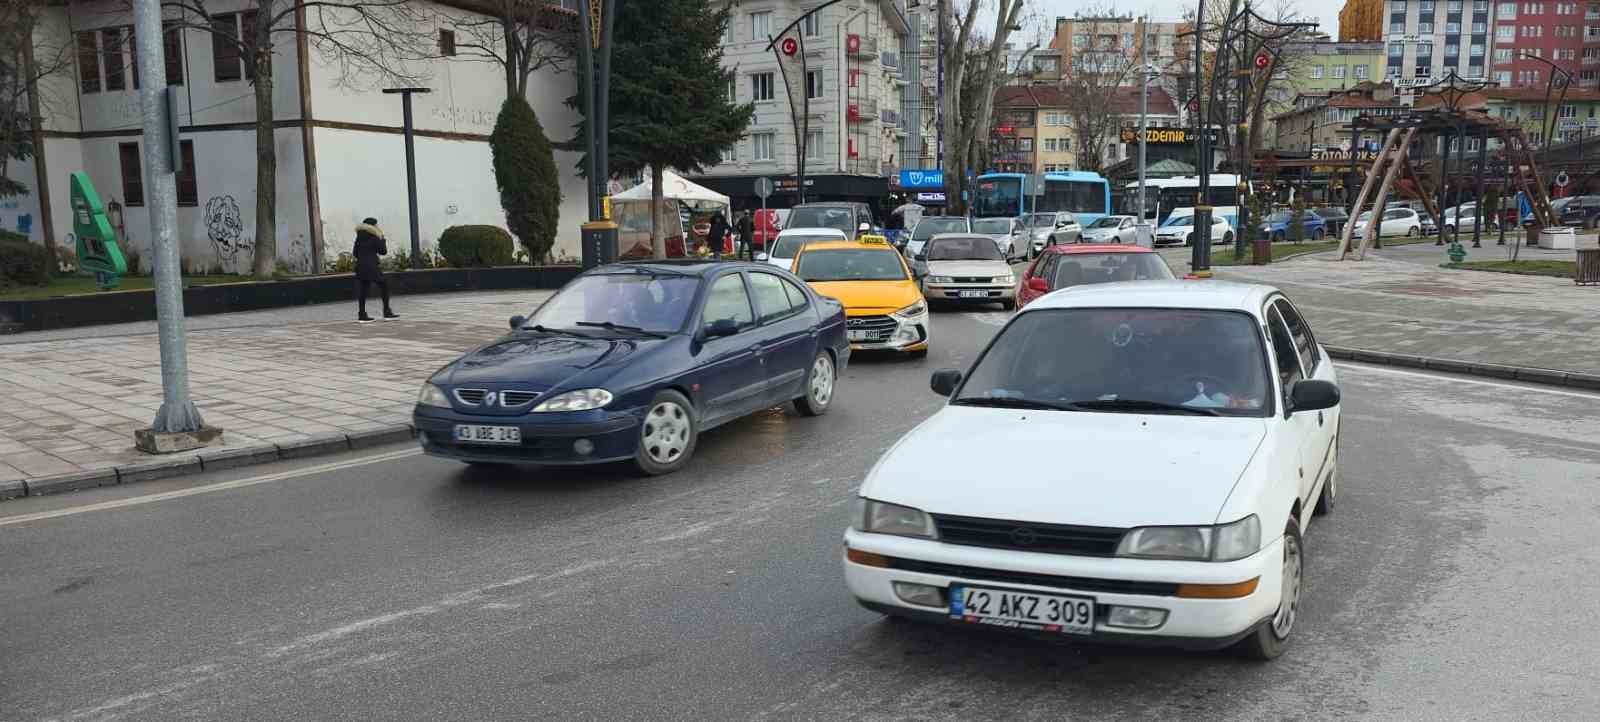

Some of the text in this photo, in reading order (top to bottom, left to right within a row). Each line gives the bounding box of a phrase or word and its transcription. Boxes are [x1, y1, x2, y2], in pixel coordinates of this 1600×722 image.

[966, 591, 1090, 625] 42 AKZ 309
